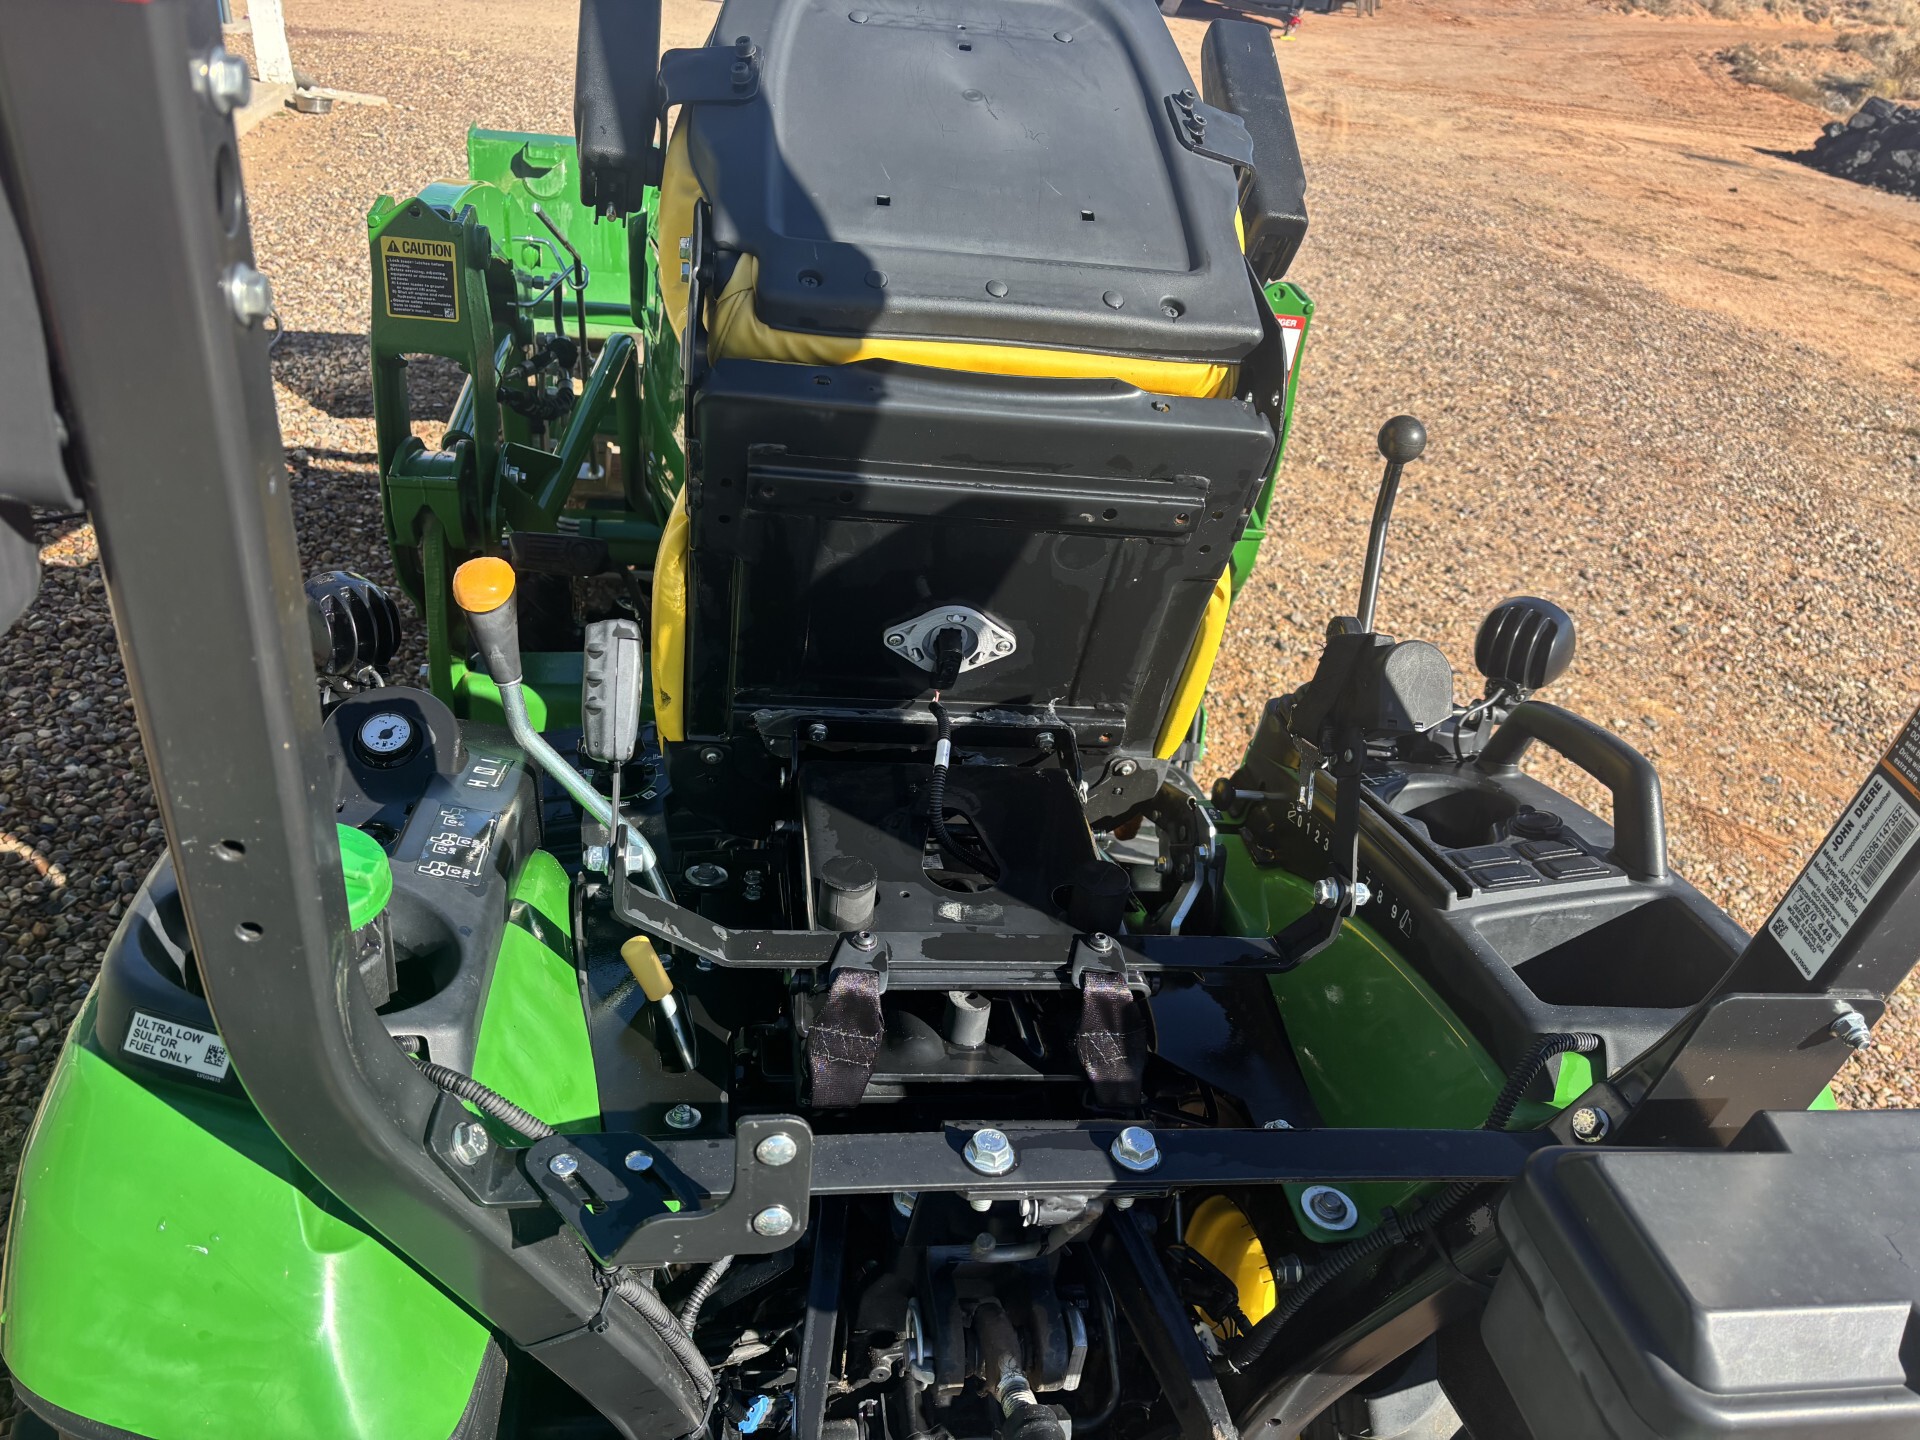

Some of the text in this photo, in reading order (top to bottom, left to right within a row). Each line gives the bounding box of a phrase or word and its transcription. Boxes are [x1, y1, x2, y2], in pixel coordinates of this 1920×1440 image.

[402, 241, 452, 257] CAUTION
[1279, 318, 1297, 328] GER
[1899, 747, 1913, 763] Drive
[1893, 757, 1919, 784] extra care.
[1831, 780, 1883, 852] JOHN DEERE
[1838, 790, 1892, 862] Component Serial Number
[1297, 815, 1329, 851] 0 1 2 3
[1804, 872, 1818, 889] Tested
[1813, 860, 1831, 883] Models:
[1822, 848, 1868, 904] Make: John Deere
[1824, 861, 1857, 902] Type: RG061
[1377, 889, 1383, 904] 8
[1391, 904, 1398, 919] 9
[1792, 903, 1807, 921] DEERE
[1808, 922, 1827, 946] COMPANY
[1796, 894, 1833, 942] 7/S/0 448
[1825, 917, 1842, 940] NUMBER
[1787, 915, 1800, 932] MADE
[1802, 934, 1817, 954] MEXICO
[1816, 942, 1825, 955] USA
[133, 1028, 178, 1050] SULFUR
[136, 1017, 204, 1044] ULTRA LOW
[129, 1039, 192, 1065] FUEL ONLY
